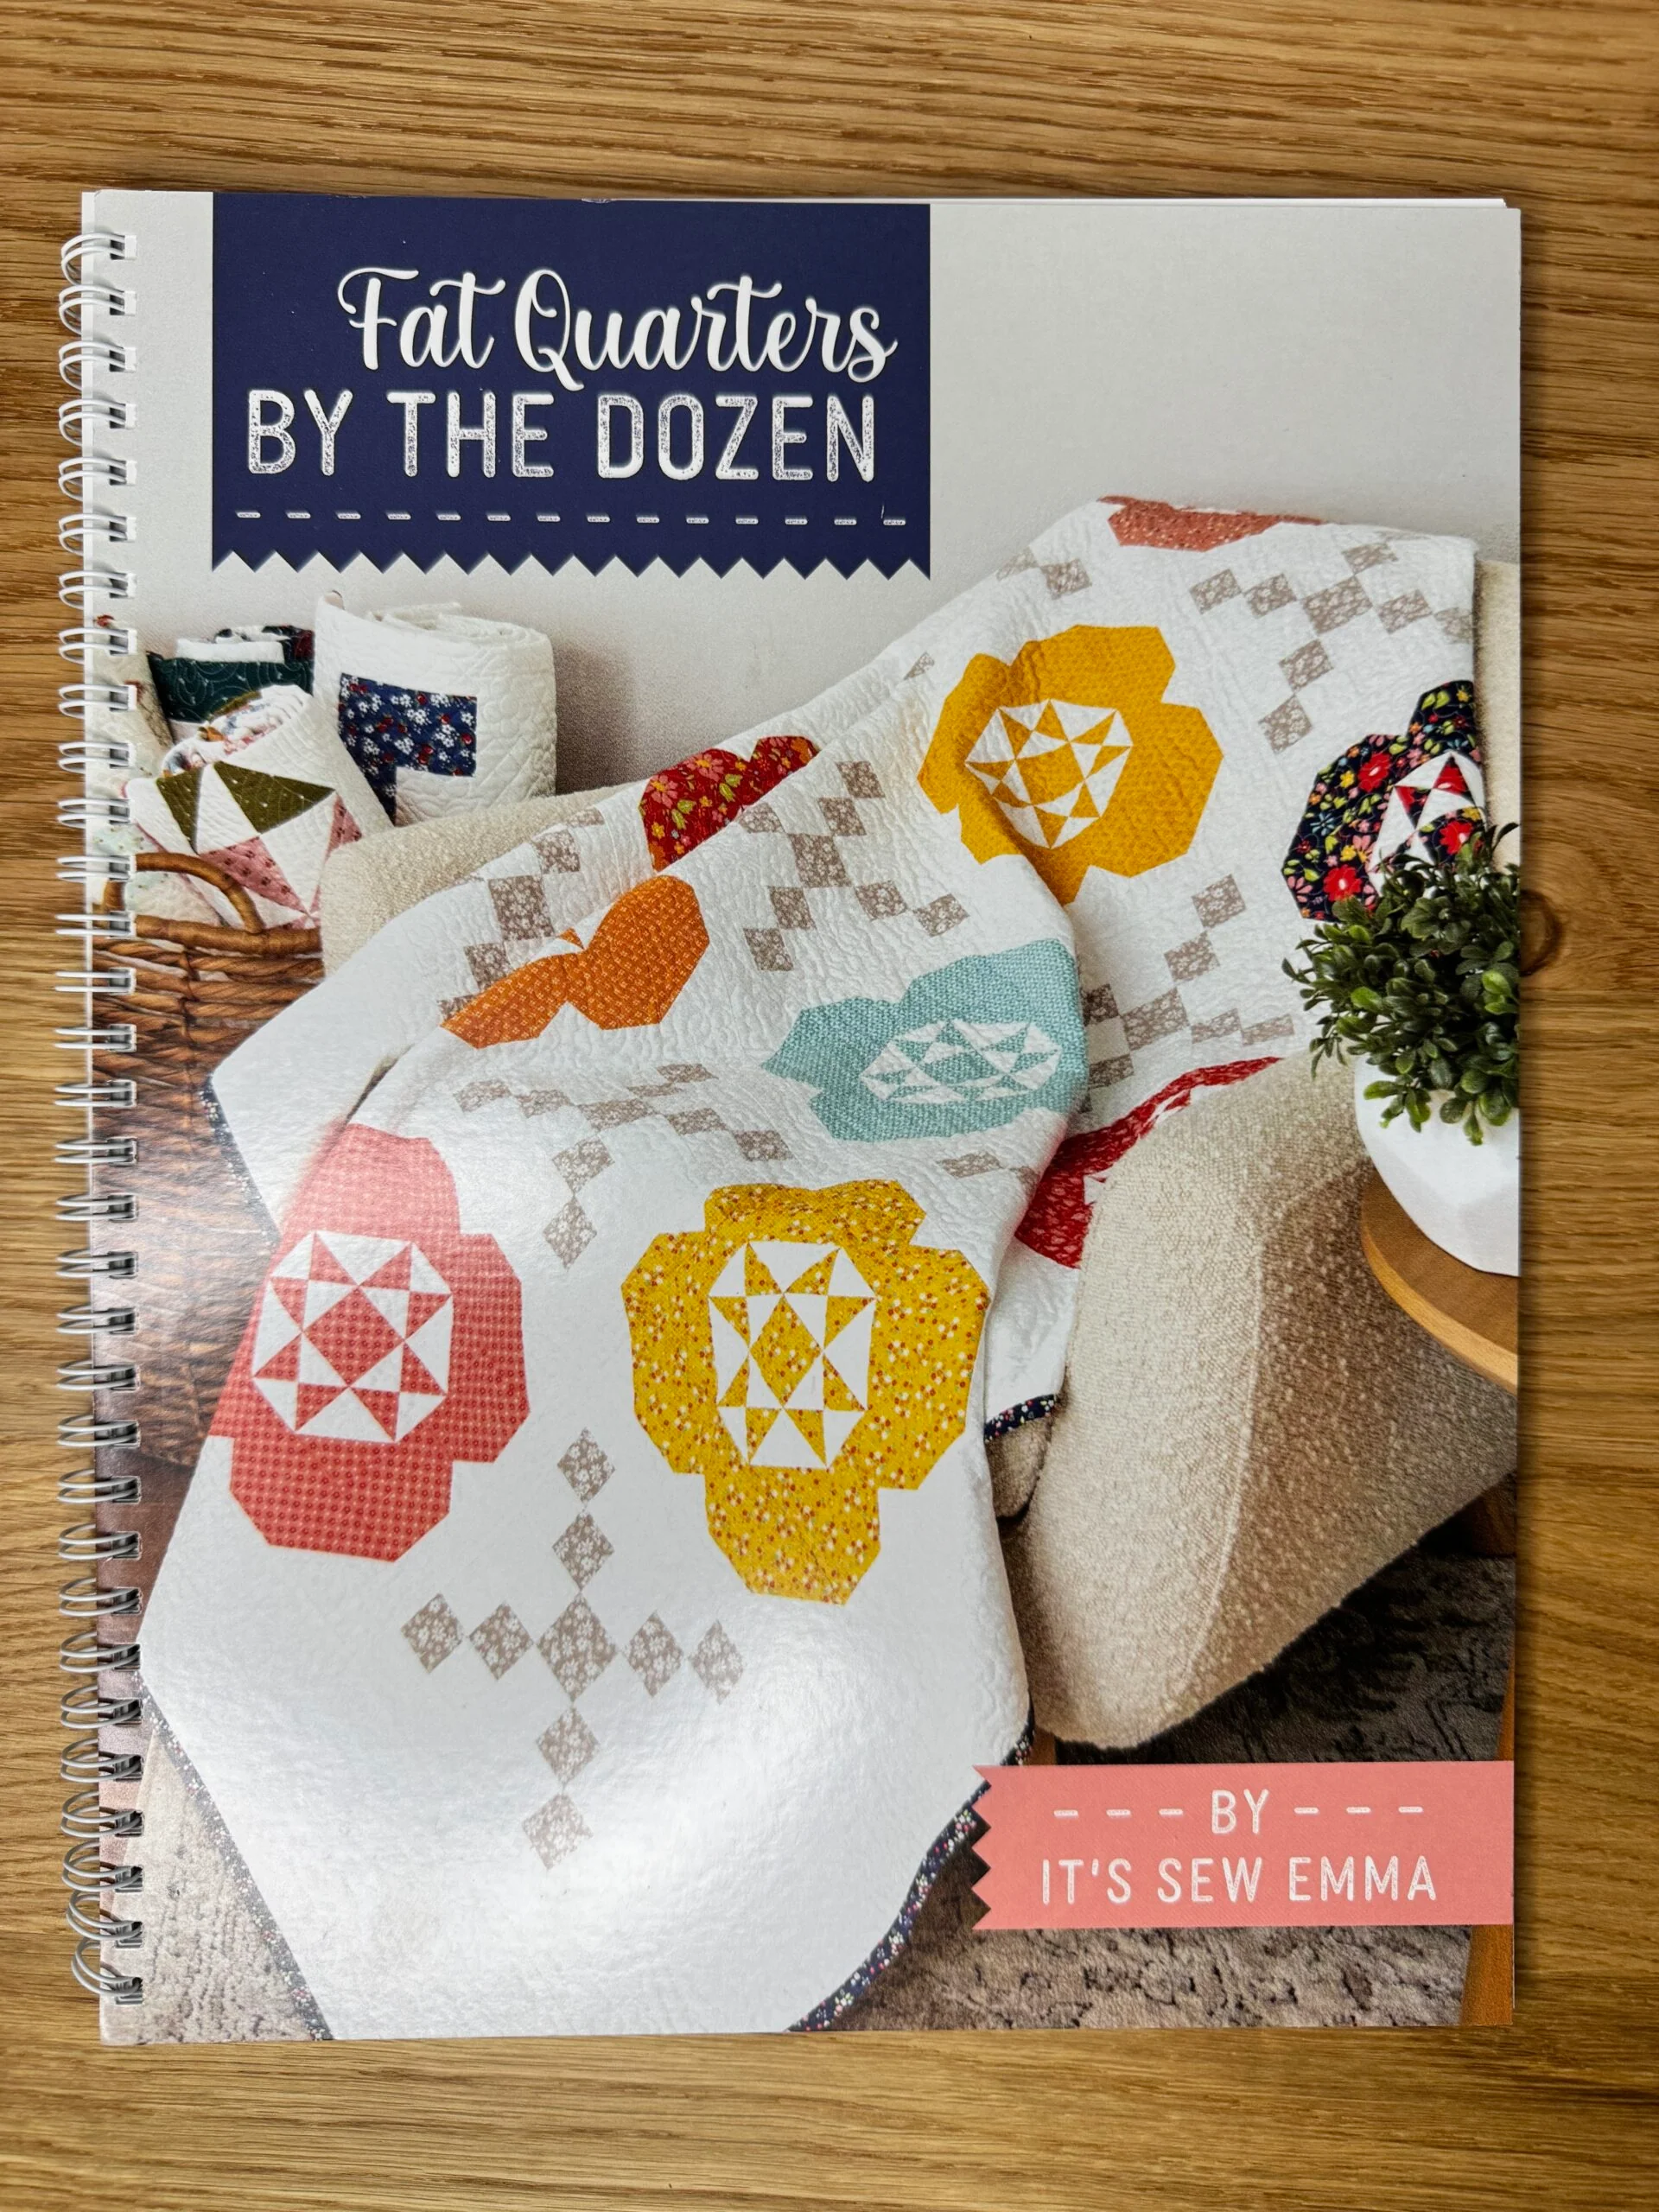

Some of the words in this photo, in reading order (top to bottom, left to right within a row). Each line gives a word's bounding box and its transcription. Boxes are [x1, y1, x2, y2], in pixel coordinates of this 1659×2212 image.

[337, 266, 506, 371] Fat
[514, 268, 899, 391] Quarters
[247, 389, 353, 476] BY
[386, 391, 555, 479] THE
[597, 393, 874, 482] DOZEN
[1211, 1789, 1269, 1834] BY
[1042, 1858, 1132, 1904] IT'S
[1157, 1857, 1262, 1904] SEW
[1288, 1856, 1436, 1902] EMMA
